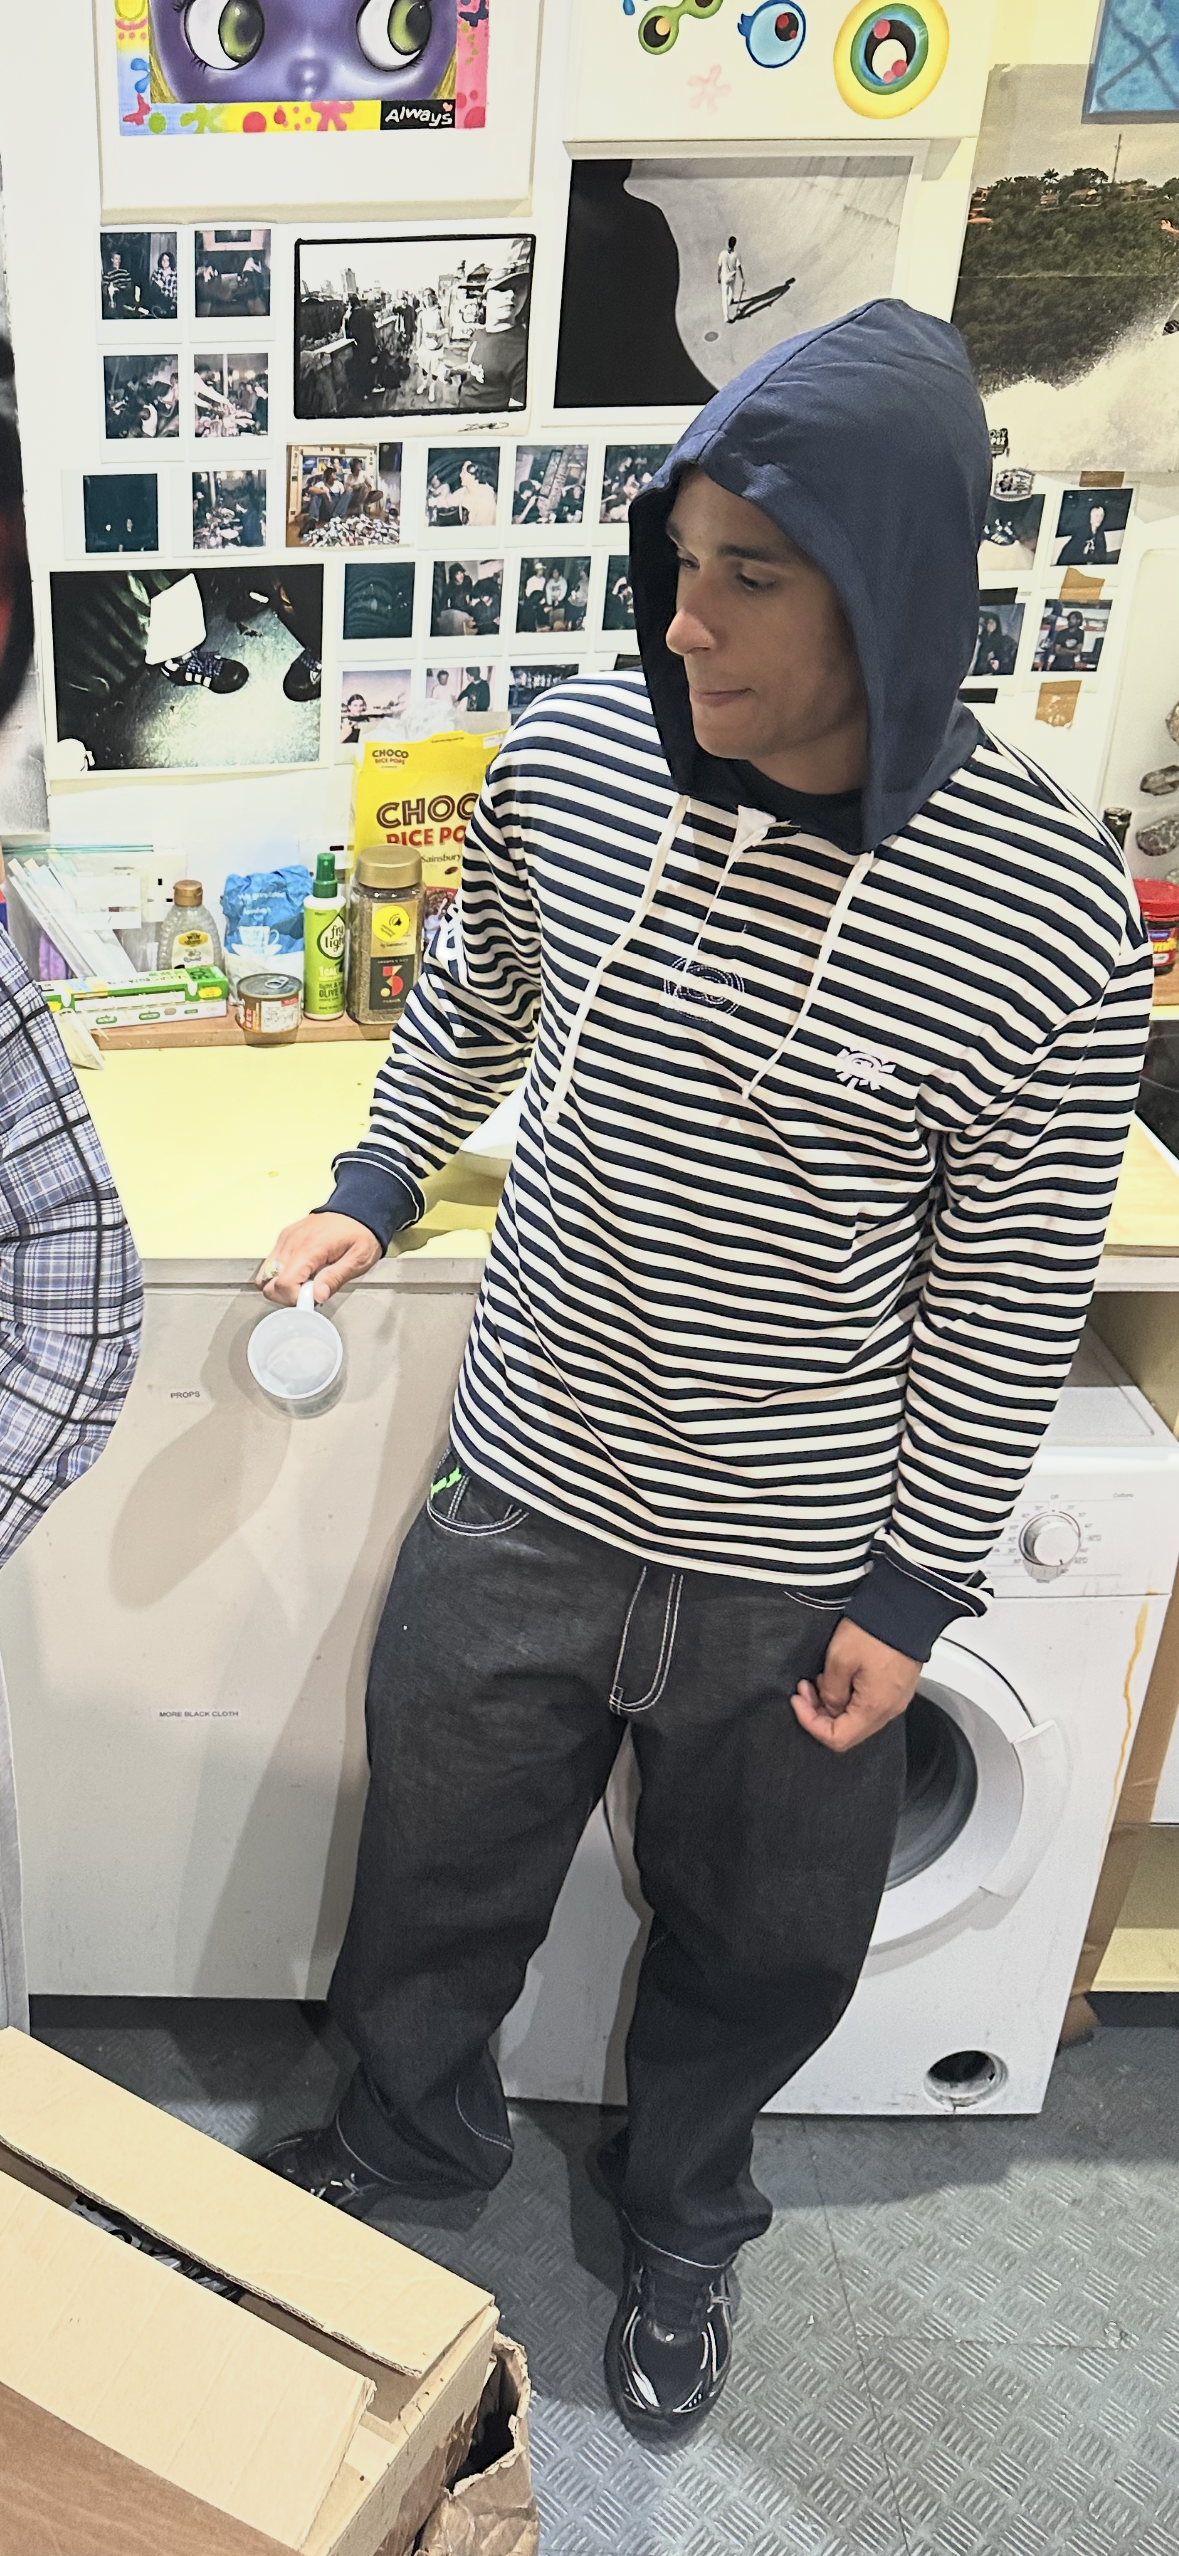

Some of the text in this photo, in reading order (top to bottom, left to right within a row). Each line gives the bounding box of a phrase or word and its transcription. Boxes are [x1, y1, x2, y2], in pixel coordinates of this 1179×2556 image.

[385, 106, 453, 127] Always
[989, 430, 1007, 438] ORY
[372, 749, 409, 759] CHOCO
[376, 793, 479, 829] CHOC
[386, 825, 467, 847] RICE PO
[421, 853, 462, 864] Sainsbury
[331, 925, 344, 940] fry
[325, 935, 345, 952] ligh
